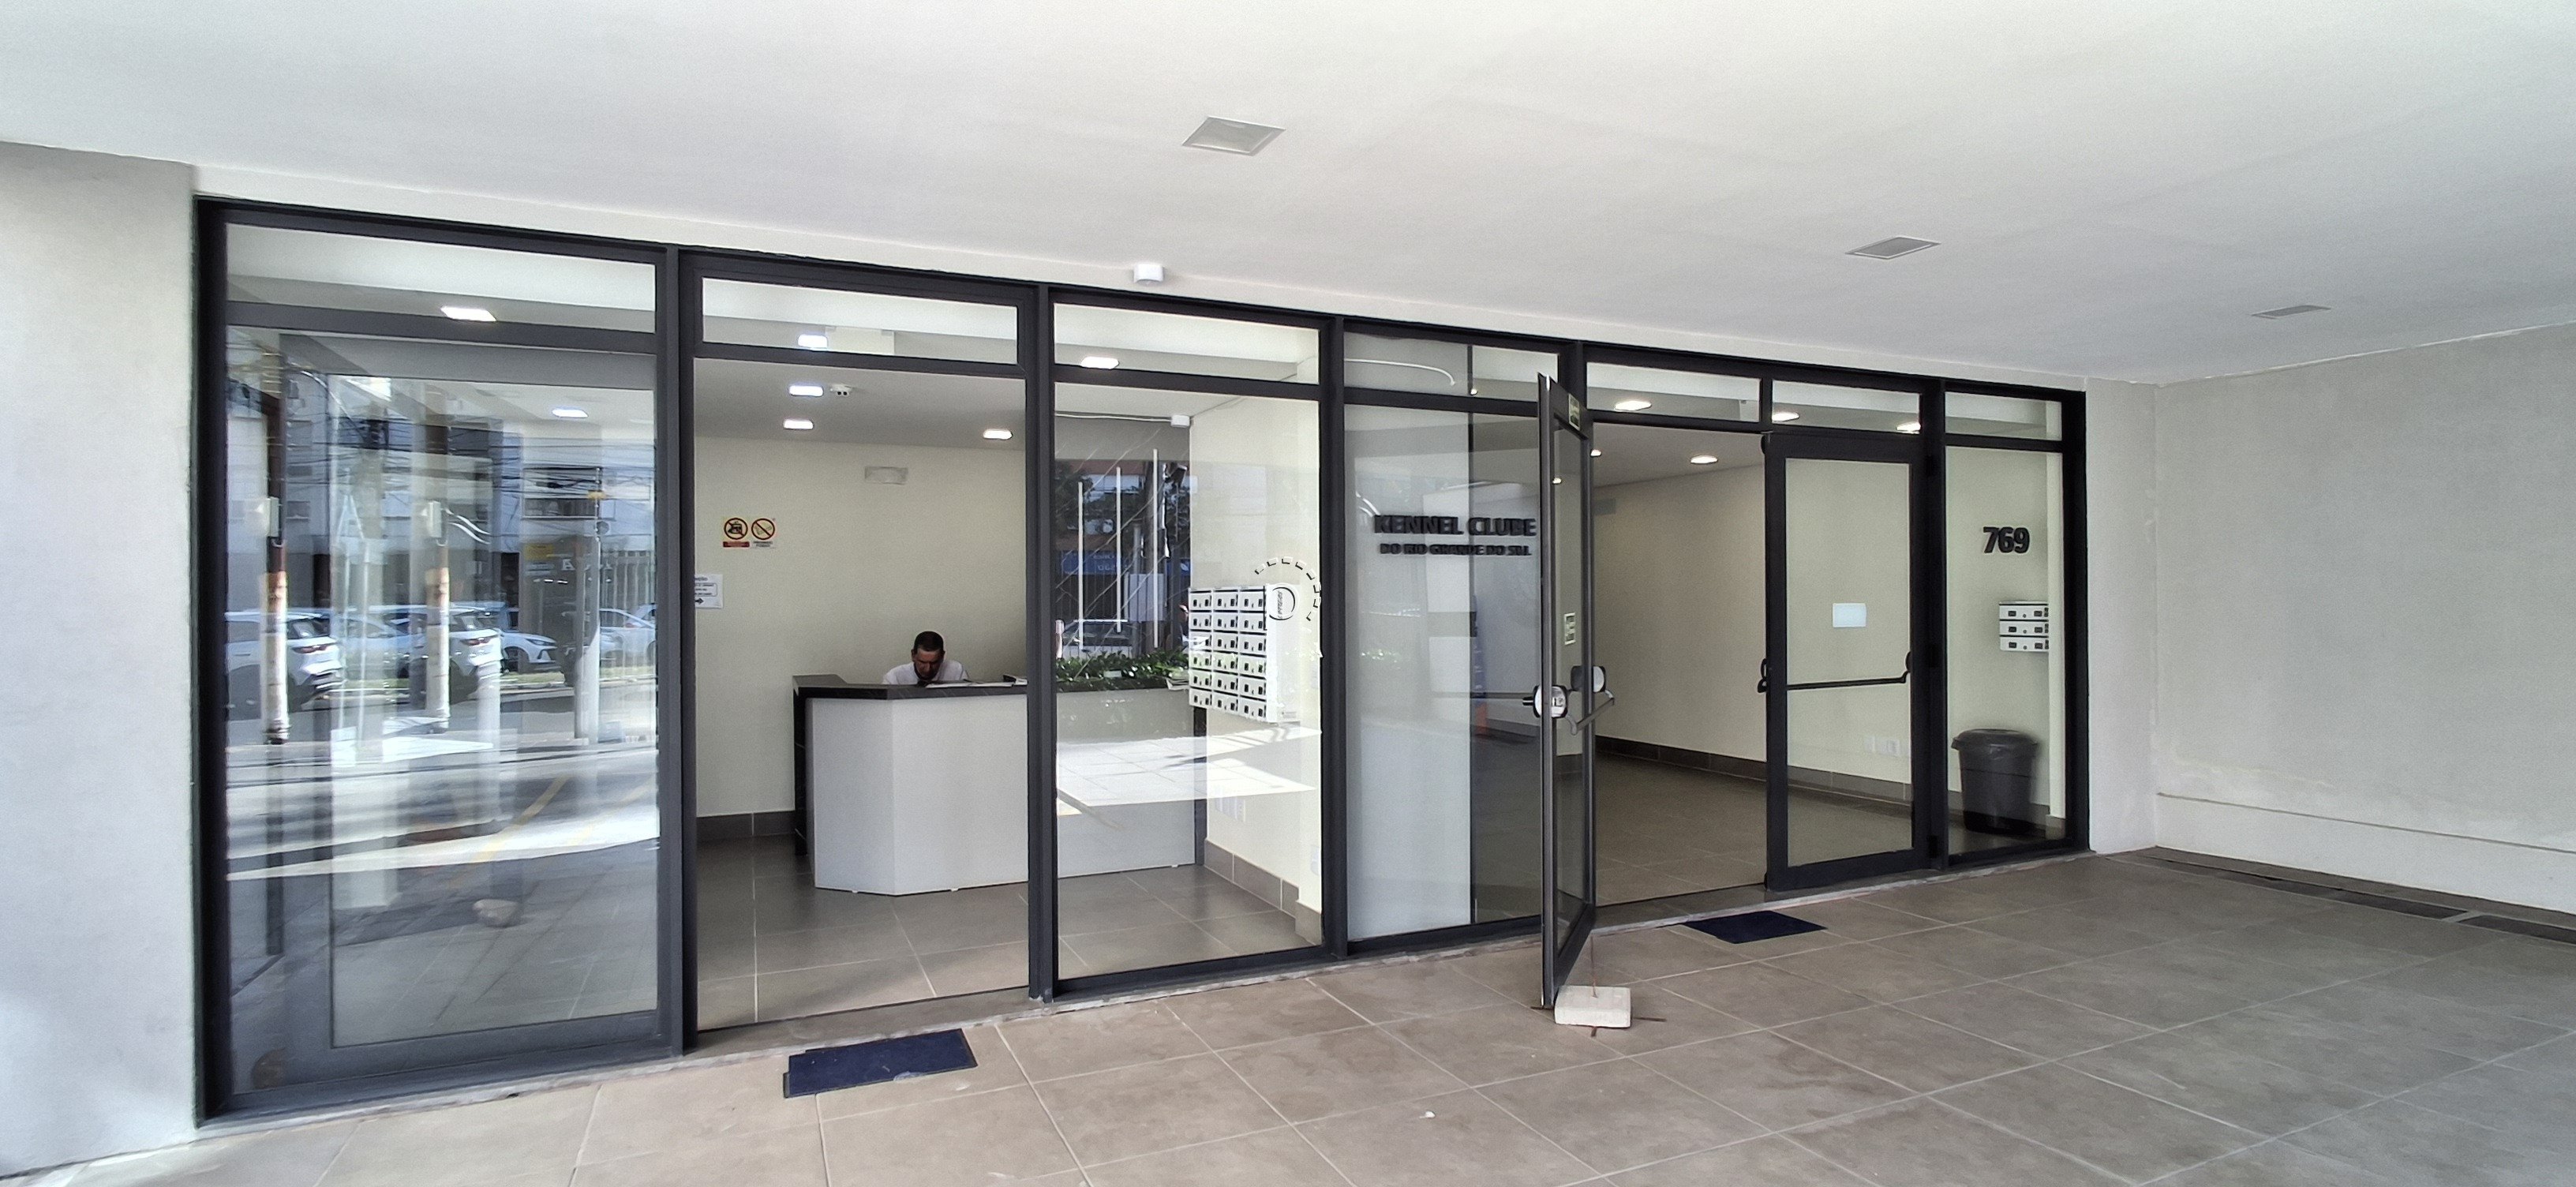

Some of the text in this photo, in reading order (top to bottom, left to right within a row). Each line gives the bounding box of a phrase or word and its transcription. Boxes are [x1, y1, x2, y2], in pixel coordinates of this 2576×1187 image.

[1374, 515, 1537, 536] KENNEL CLUBE
[1380, 543, 1532, 556] DO RIO GRANDE DO SUL
[1983, 526, 2030, 553] 769
